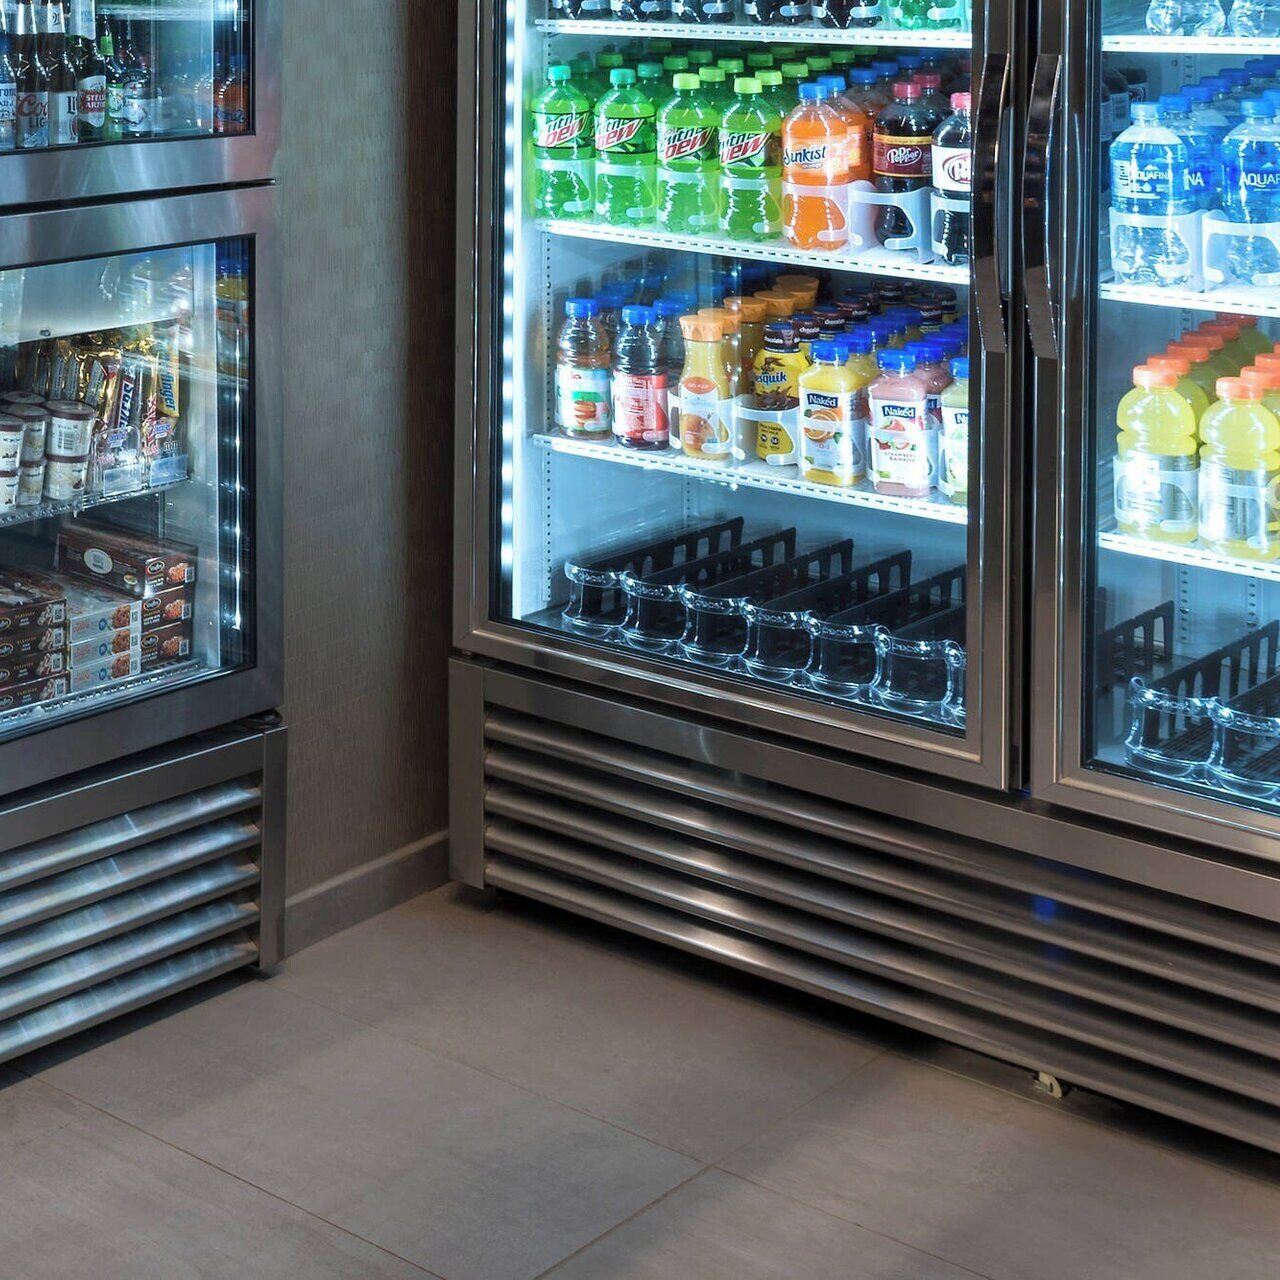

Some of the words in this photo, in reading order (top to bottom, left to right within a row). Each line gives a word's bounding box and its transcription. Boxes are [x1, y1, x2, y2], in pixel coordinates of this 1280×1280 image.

[783, 145, 829, 166] Sunkist
[890, 149, 920, 165] Pepper
[808, 395, 837, 407] Naked
[883, 406, 915, 417] Naked
